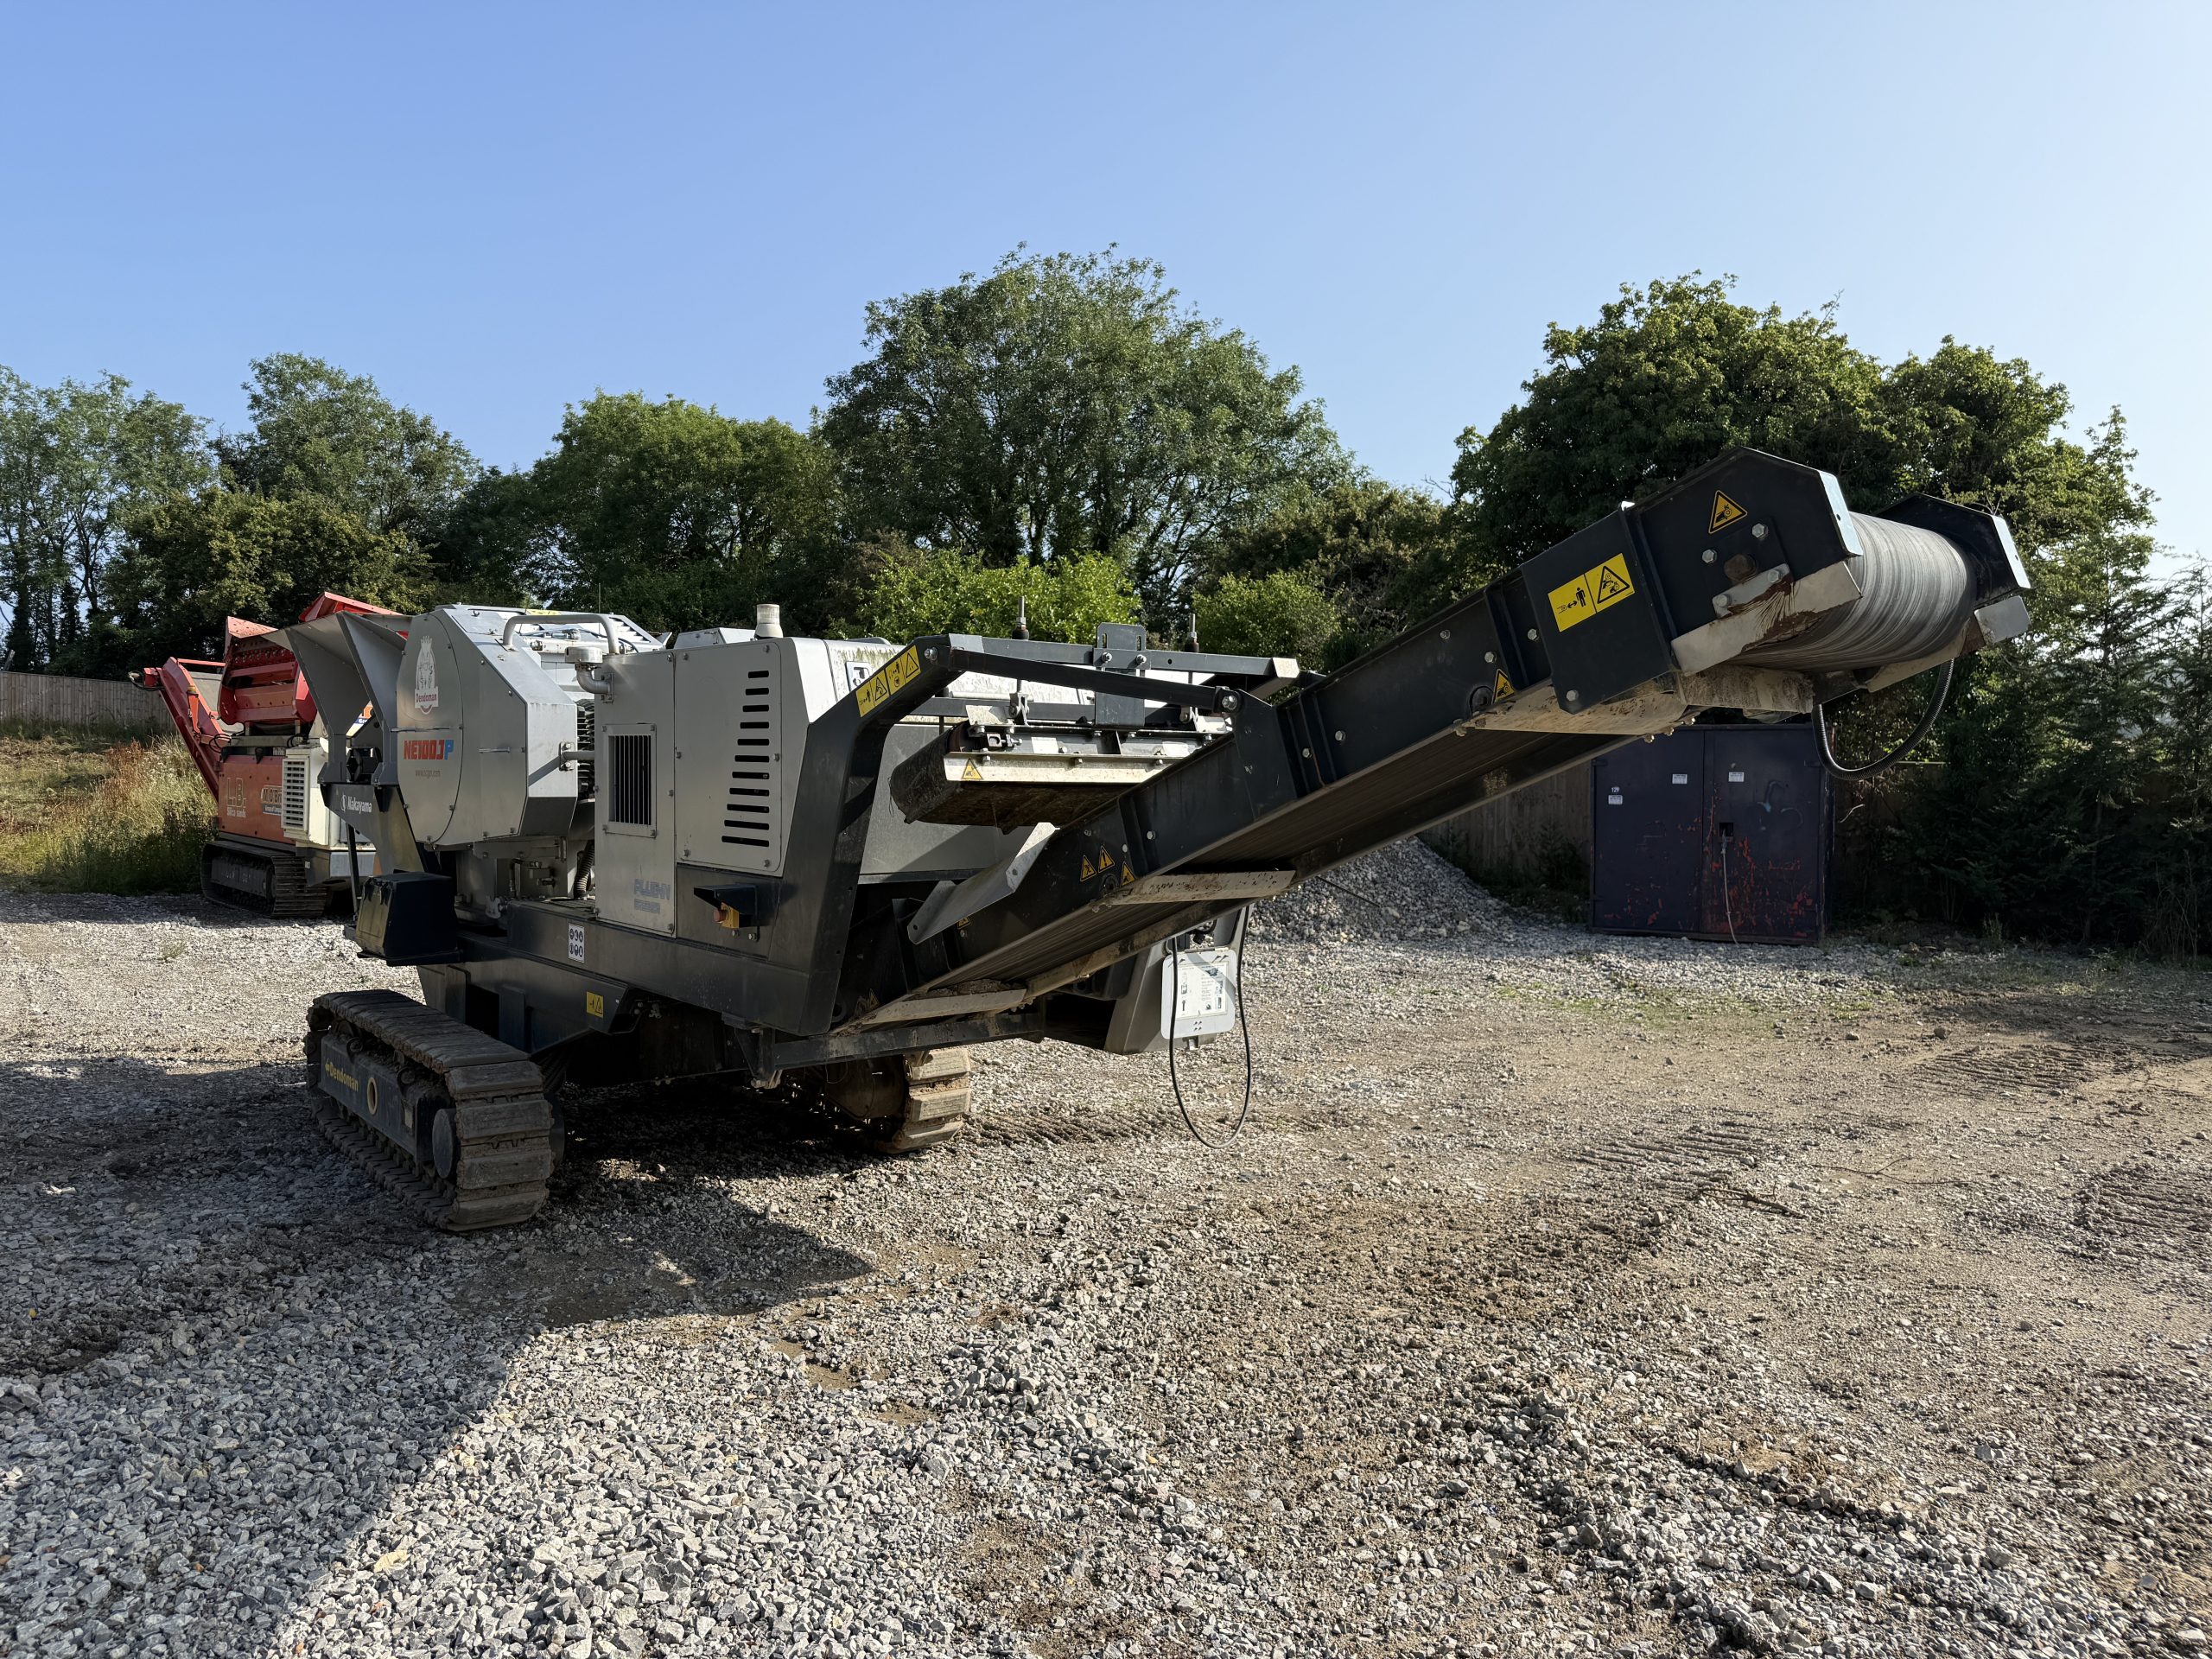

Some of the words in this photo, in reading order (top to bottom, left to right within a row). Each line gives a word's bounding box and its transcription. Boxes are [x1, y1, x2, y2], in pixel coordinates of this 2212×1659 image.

[416, 692, 437, 703] Dendoman
[347, 796, 372, 814] Nakayama
[329, 1061, 359, 1092] Dendoman
